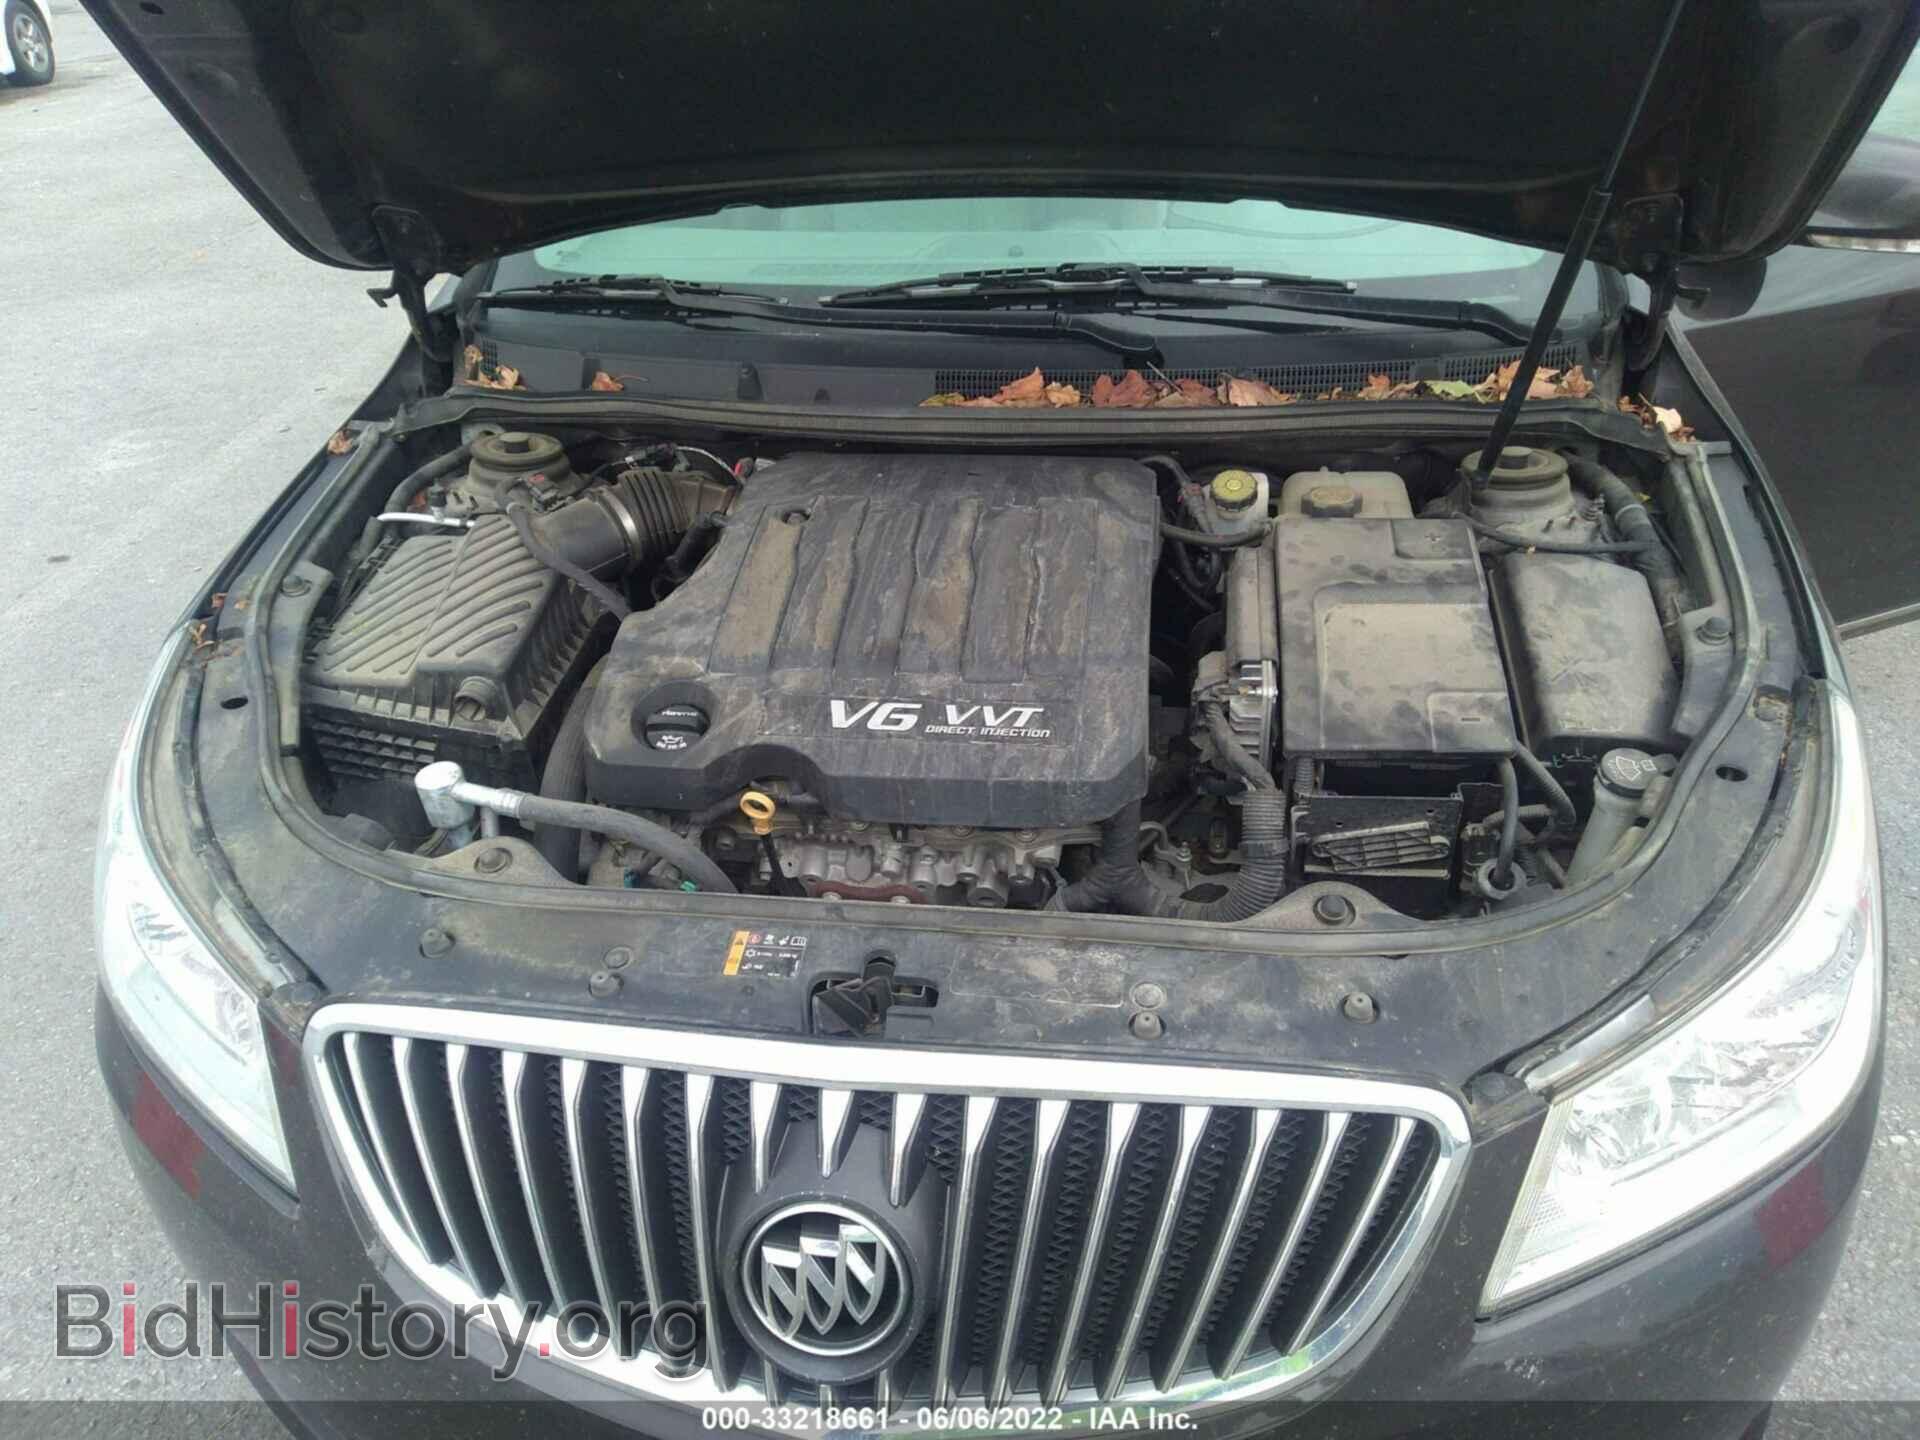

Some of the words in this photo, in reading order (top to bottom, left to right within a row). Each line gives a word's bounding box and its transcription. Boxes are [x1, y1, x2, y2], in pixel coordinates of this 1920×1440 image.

[830, 700, 923, 731] V6
[945, 704, 1044, 728] VVT
[925, 724, 976, 735] DIRECT
